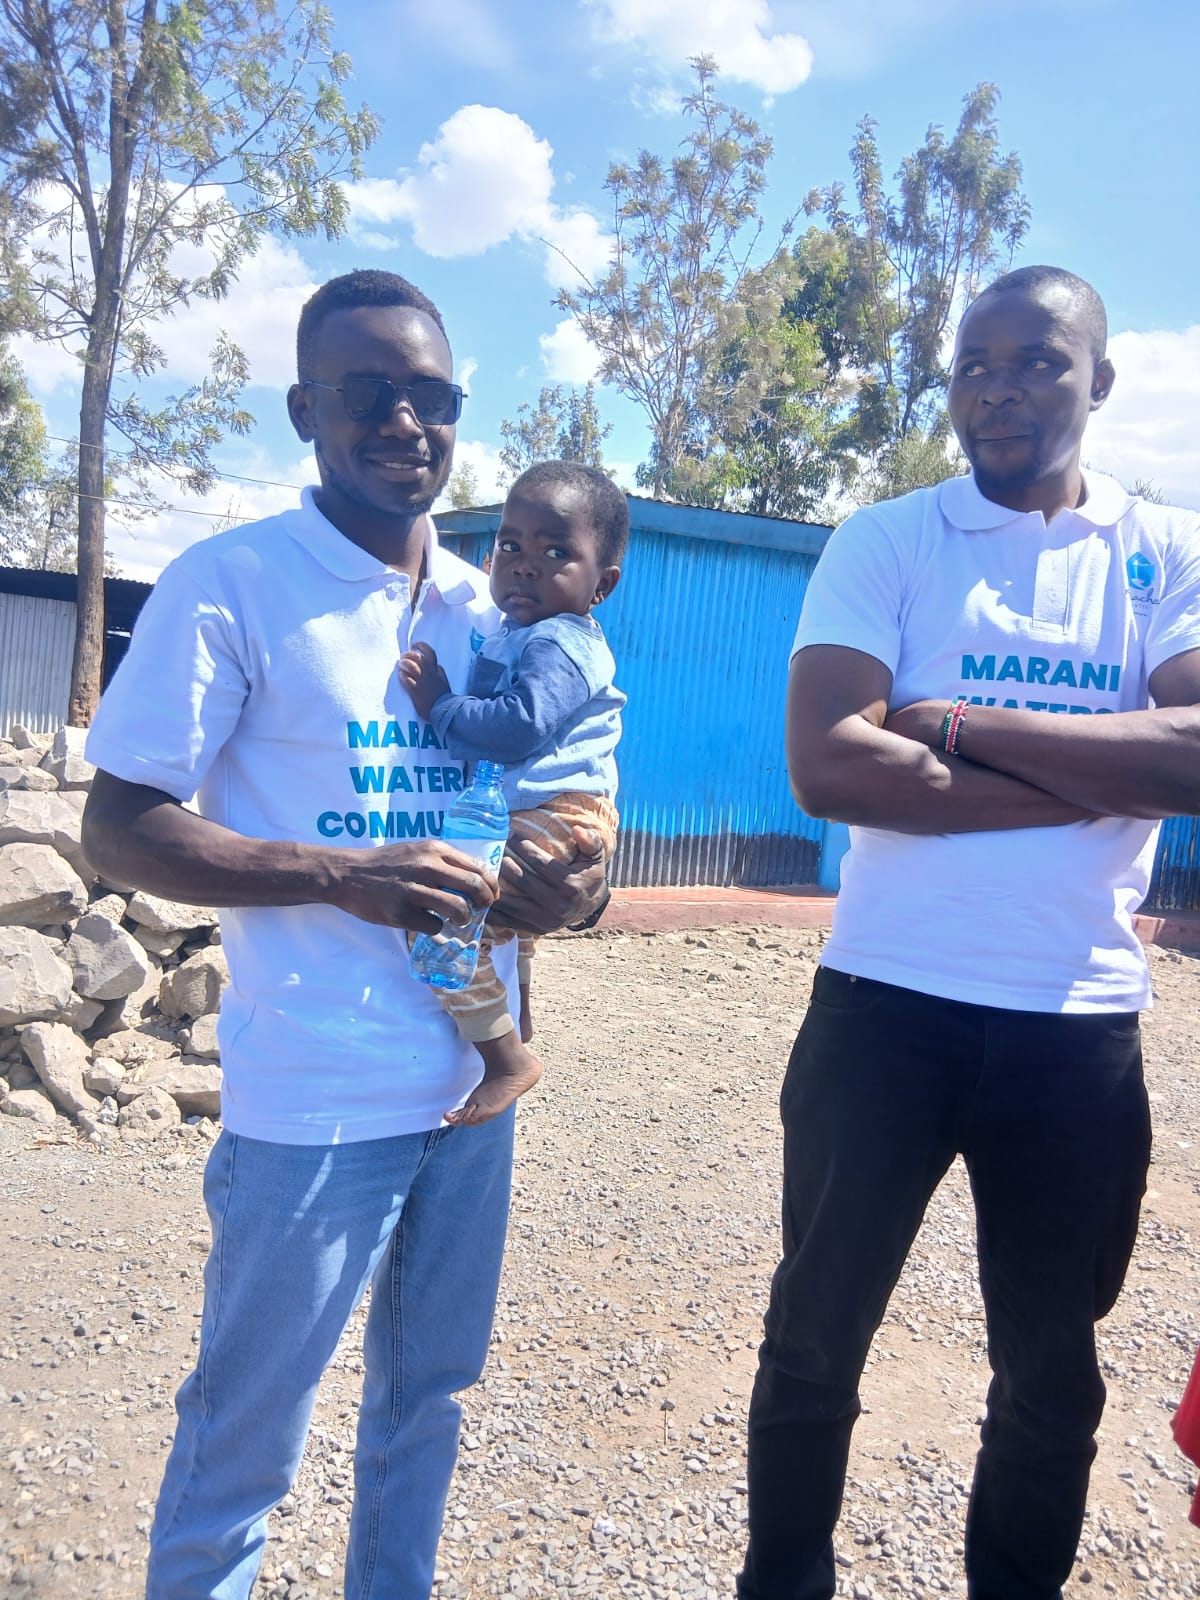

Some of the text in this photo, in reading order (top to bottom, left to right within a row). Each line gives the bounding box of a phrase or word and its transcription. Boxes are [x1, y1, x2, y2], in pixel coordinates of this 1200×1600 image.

[961, 655, 1121, 692] MARANI
[347, 721, 448, 750] MARA
[349, 765, 467, 794] WATER
[317, 810, 447, 839] COMMU
